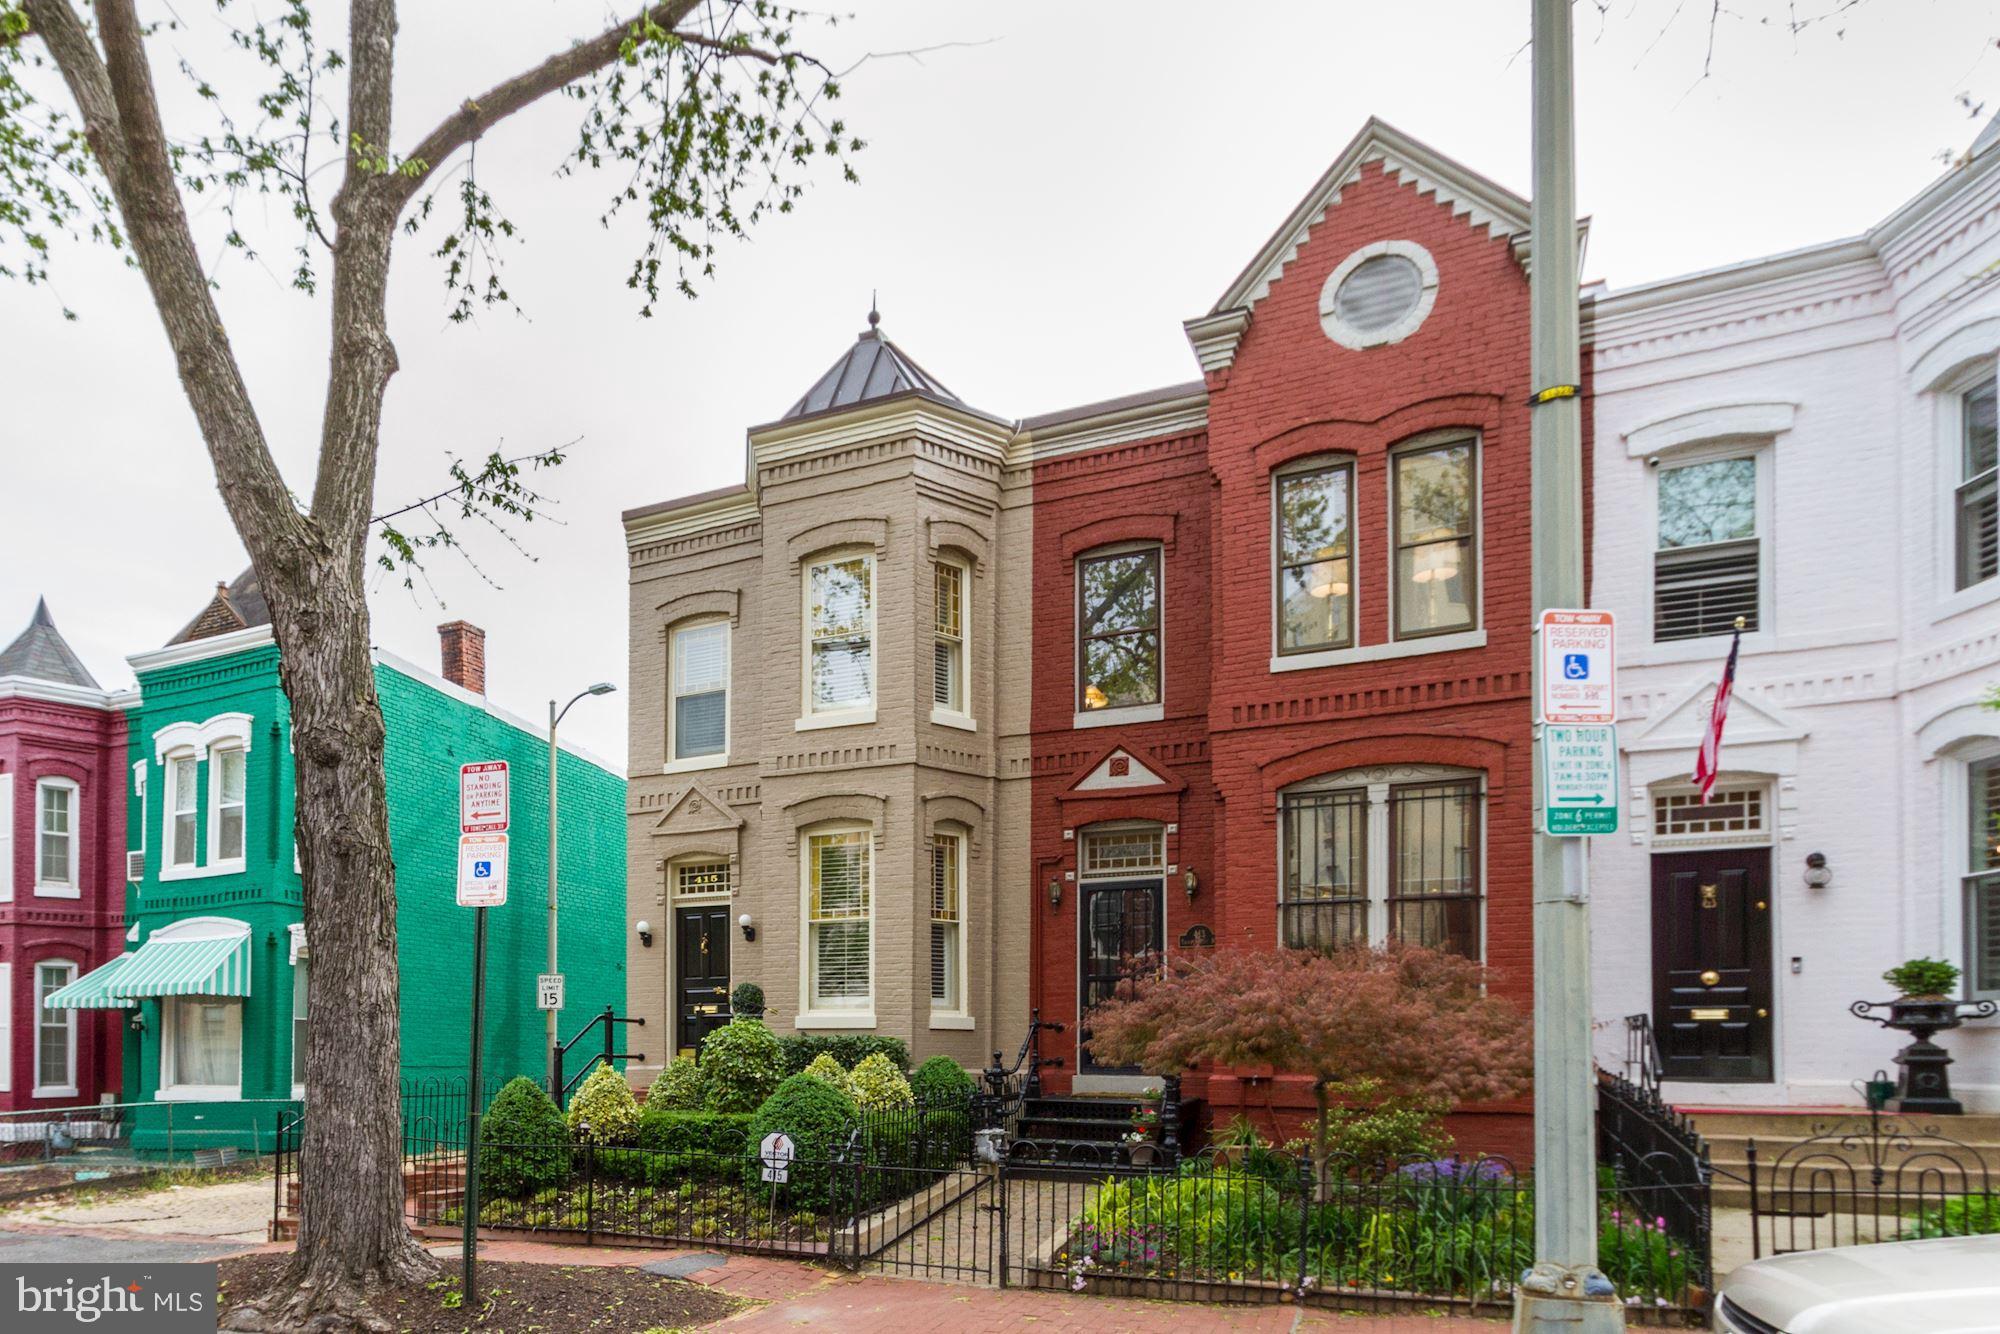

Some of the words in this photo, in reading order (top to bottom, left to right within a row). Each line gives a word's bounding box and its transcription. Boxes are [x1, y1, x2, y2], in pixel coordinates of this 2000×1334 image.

[1550, 627, 1608, 637] RESERVED
[1552, 639, 1606, 649] PARKING
[1551, 729, 1572, 742] TWO
[1576, 729, 1607, 742] HOUR
[1559, 746, 1603, 757] PARKING
[482, 763, 503, 771] AWAY
[466, 782, 502, 791] STANDING
[476, 791, 502, 799] PARKING
[471, 799, 501, 807] ANYTIME
[1554, 812, 1573, 820] ZONE
[1575, 809, 1583, 822] 6
[466, 851, 501, 859] PARKING
[694, 874, 718, 884] 415
[544, 992, 558, 1005] 15
[768, 1170, 782, 1180] 45
